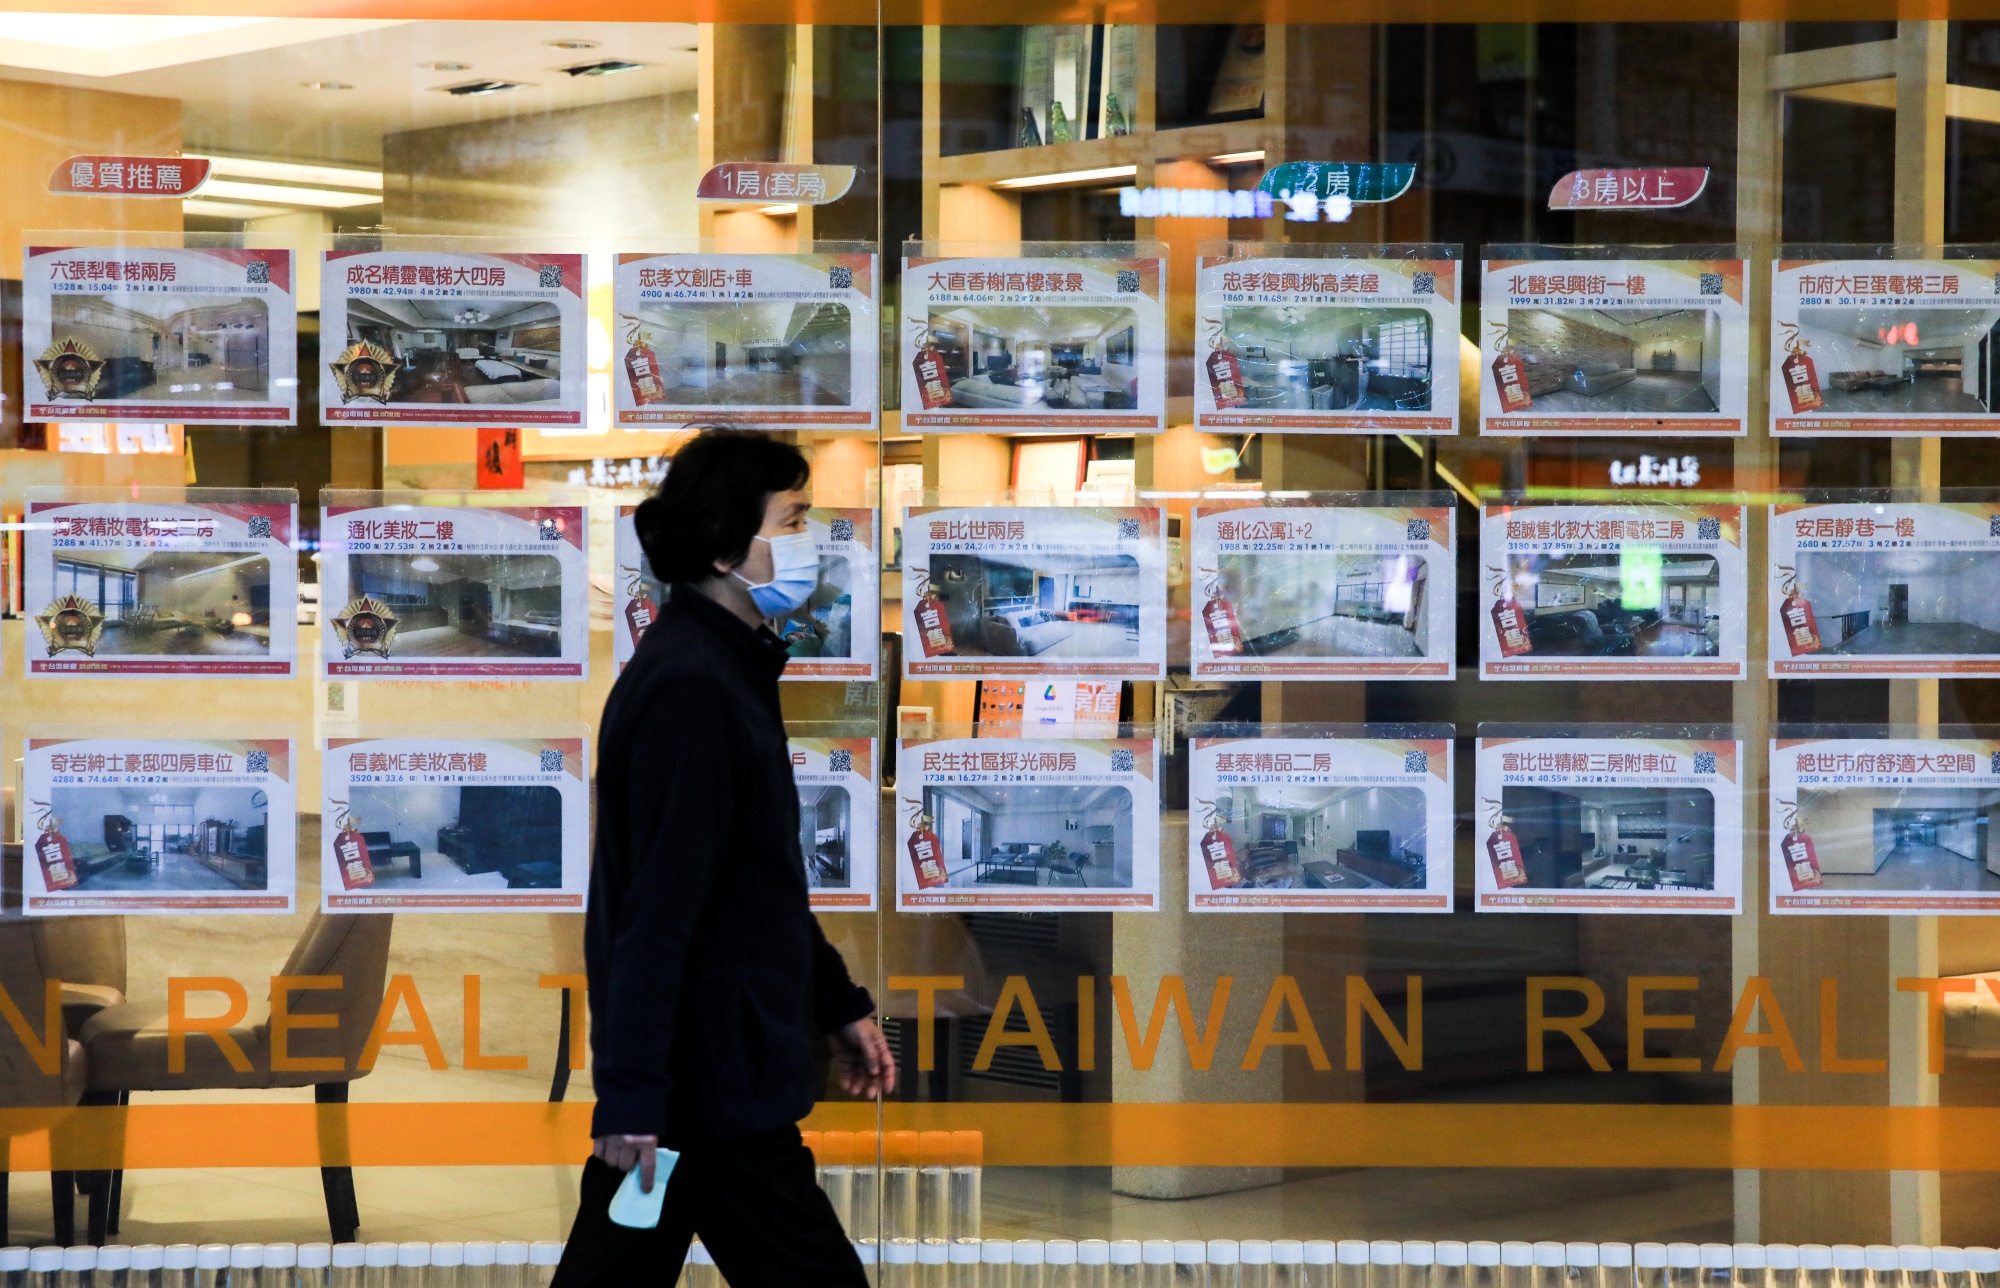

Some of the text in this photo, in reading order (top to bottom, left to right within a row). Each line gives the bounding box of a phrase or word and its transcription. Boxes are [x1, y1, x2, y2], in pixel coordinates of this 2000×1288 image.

[70, 162, 182, 191] 優質推薦
[723, 170, 826, 200] 1房(套房)
[1305, 171, 1350, 195] 2房
[1578, 175, 1676, 202] 3房以上
[50, 261, 176, 281] 六張犁電梯兩房
[347, 265, 506, 286] 成名精靈電梯大四房
[639, 268, 752, 288] 忠孝文創店+車
[1222, 273, 1379, 293] 忠孝復興挑高美屋
[1508, 275, 1645, 295] 北醫吳興街一樓
[1799, 275, 1959, 295] 市府大巨蛋電梯三房
[348, 520, 454, 540] 通化美妝二樓
[929, 521, 1025, 540] 富比世兩房
[1218, 521, 1313, 540] 通化公寓1+2
[1795, 517, 1915, 538] 安居靜巷一樓
[348, 752, 487, 772] 信義ME美妝高樓
[923, 752, 1076, 771] 民生社區採光兩房
[1215, 753, 1331, 772] 基泰精品二房
[168, 974, 588, 1073] REALT
[888, 974, 2000, 1075] TAIWAN REALT
